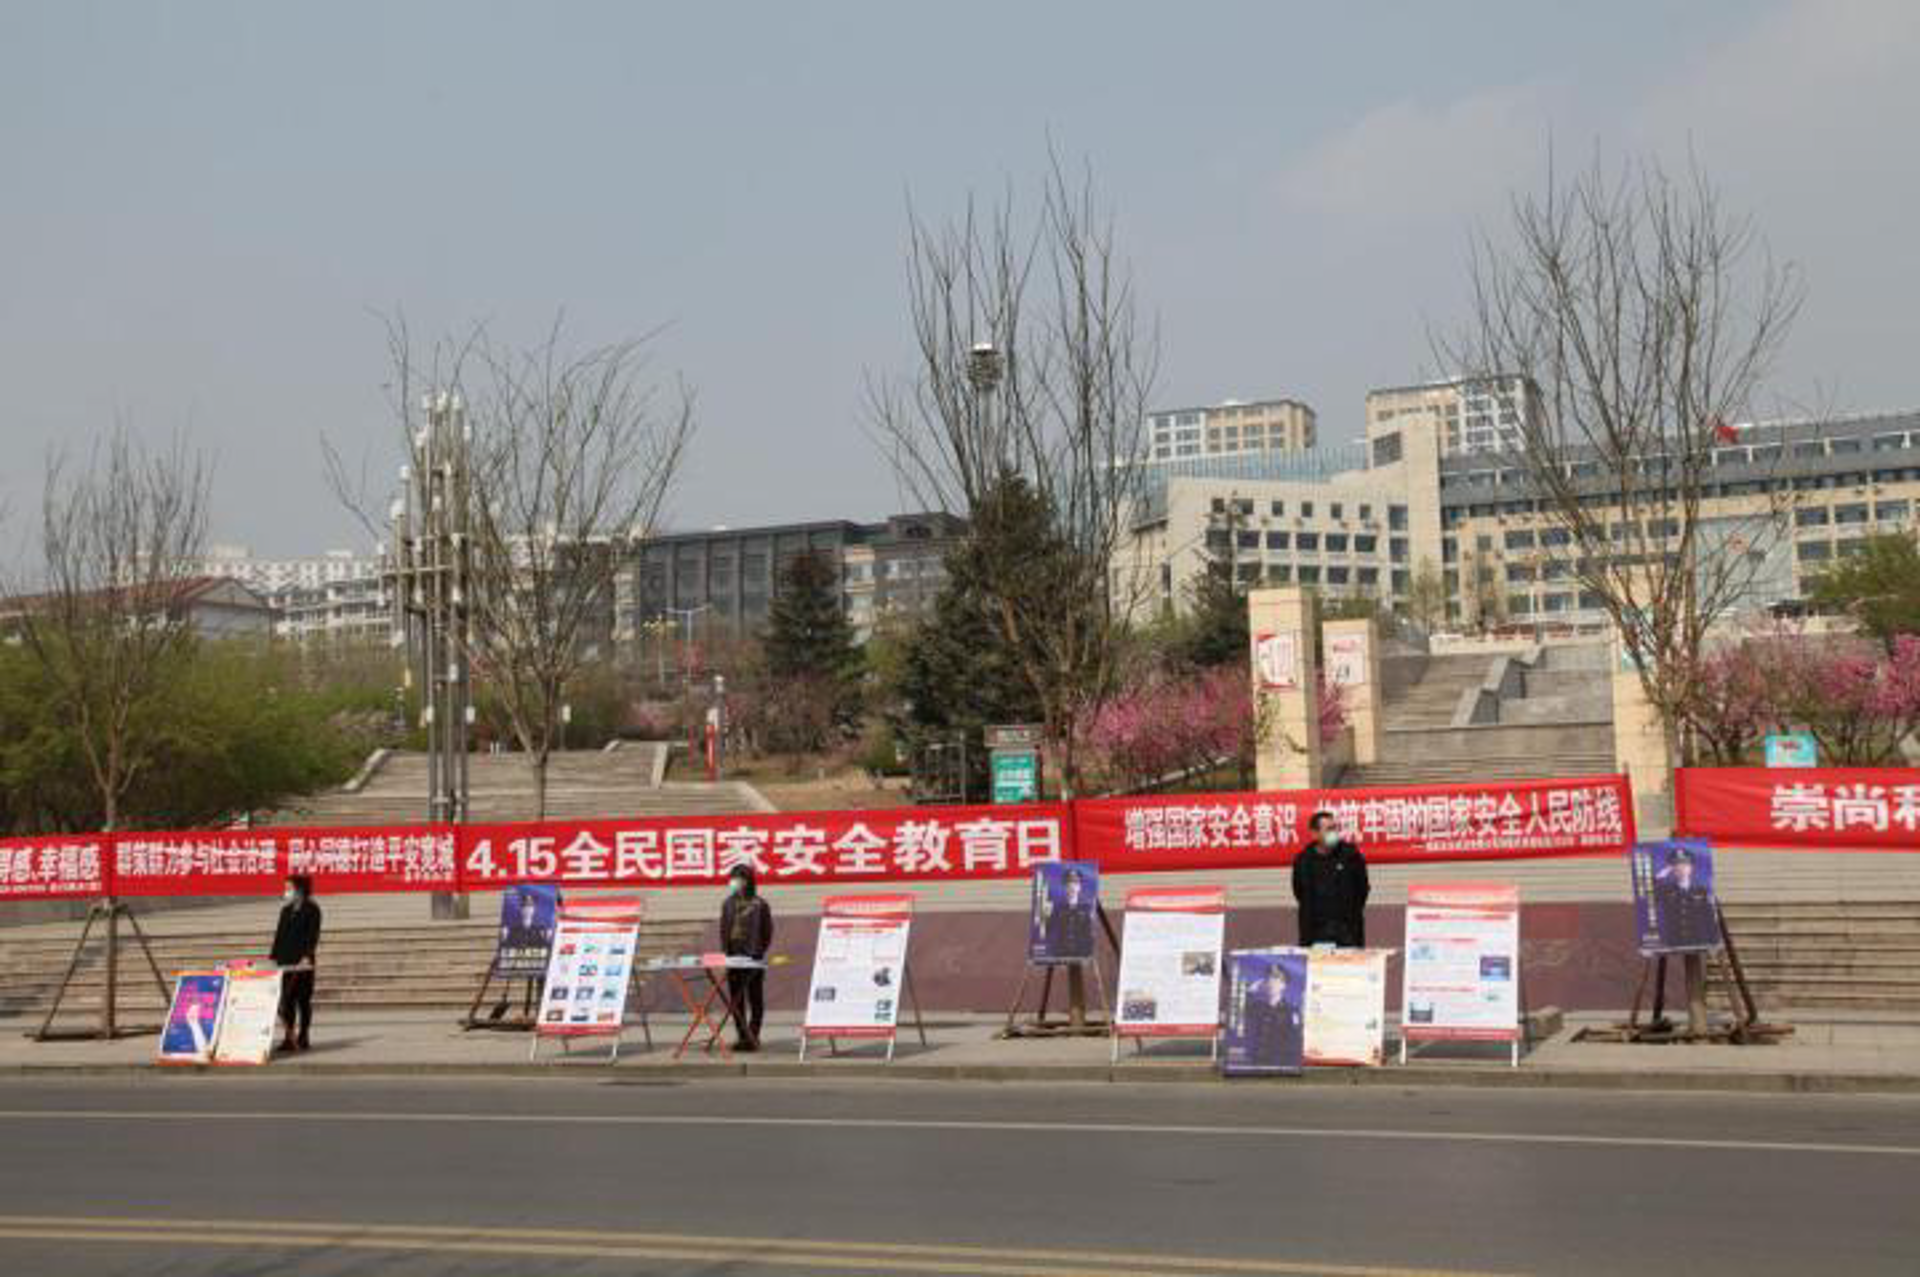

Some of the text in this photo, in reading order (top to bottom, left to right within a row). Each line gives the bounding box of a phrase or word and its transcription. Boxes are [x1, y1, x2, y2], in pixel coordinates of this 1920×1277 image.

[466, 819, 1061, 880] 4.15全民国家安全教育日
[1125, 803, 1299, 850] 增强国家安全意识
